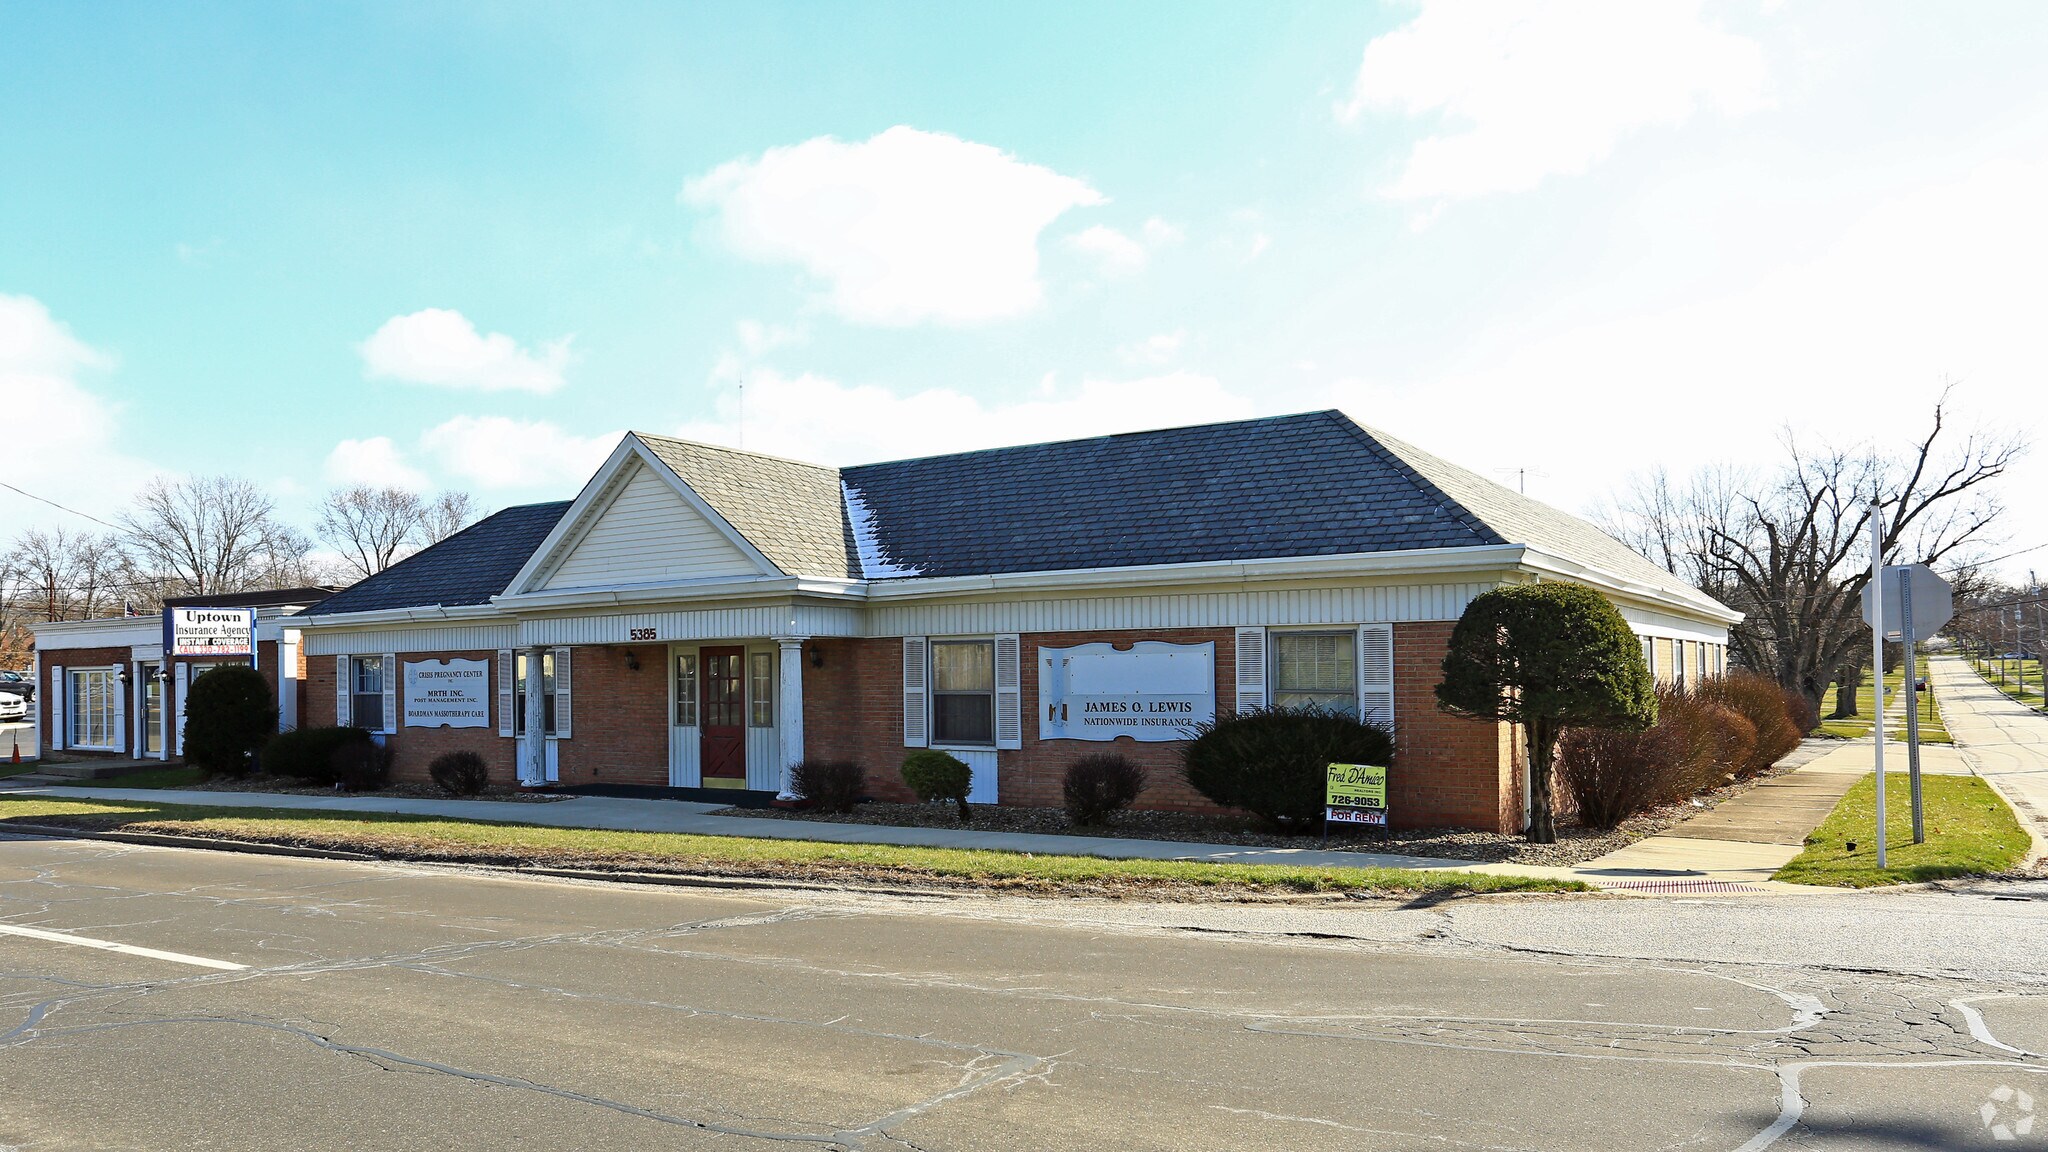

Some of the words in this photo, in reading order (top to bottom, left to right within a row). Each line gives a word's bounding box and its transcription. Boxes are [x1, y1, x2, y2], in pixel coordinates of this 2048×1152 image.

[186, 611, 241, 624] Uptown
[176, 624, 218, 635] Insurance
[221, 624, 251, 637] Agency
[630, 628, 657, 640] 5385
[179, 637, 210, 646] INSTANT
[212, 637, 249, 646] COVERAGE
[179, 645, 197, 654] CALL
[199, 645, 249, 654] 330-782-1199
[418, 671, 434, 679] CRISIS
[434, 670, 462, 678] PREGNANCY
[463, 670, 483, 678] CENTER
[1084, 702, 1127, 713] JAMES
[1131, 702, 1144, 713] O.
[1149, 701, 1192, 713] LEWIS
[434, 710, 471, 718] MASSOTHERAPY
[471, 710, 485, 718] CARE
[1084, 718, 1138, 726] NATIONWIDE
[1141, 718, 1193, 727] INSURANCE
[1328, 767, 1347, 783] Fred
[1348, 767, 1385, 786] D'Amico
[1331, 795, 1380, 807] 726-9053
[1331, 811, 1352, 821] FOR
[1354, 813, 1382, 823] RENT
